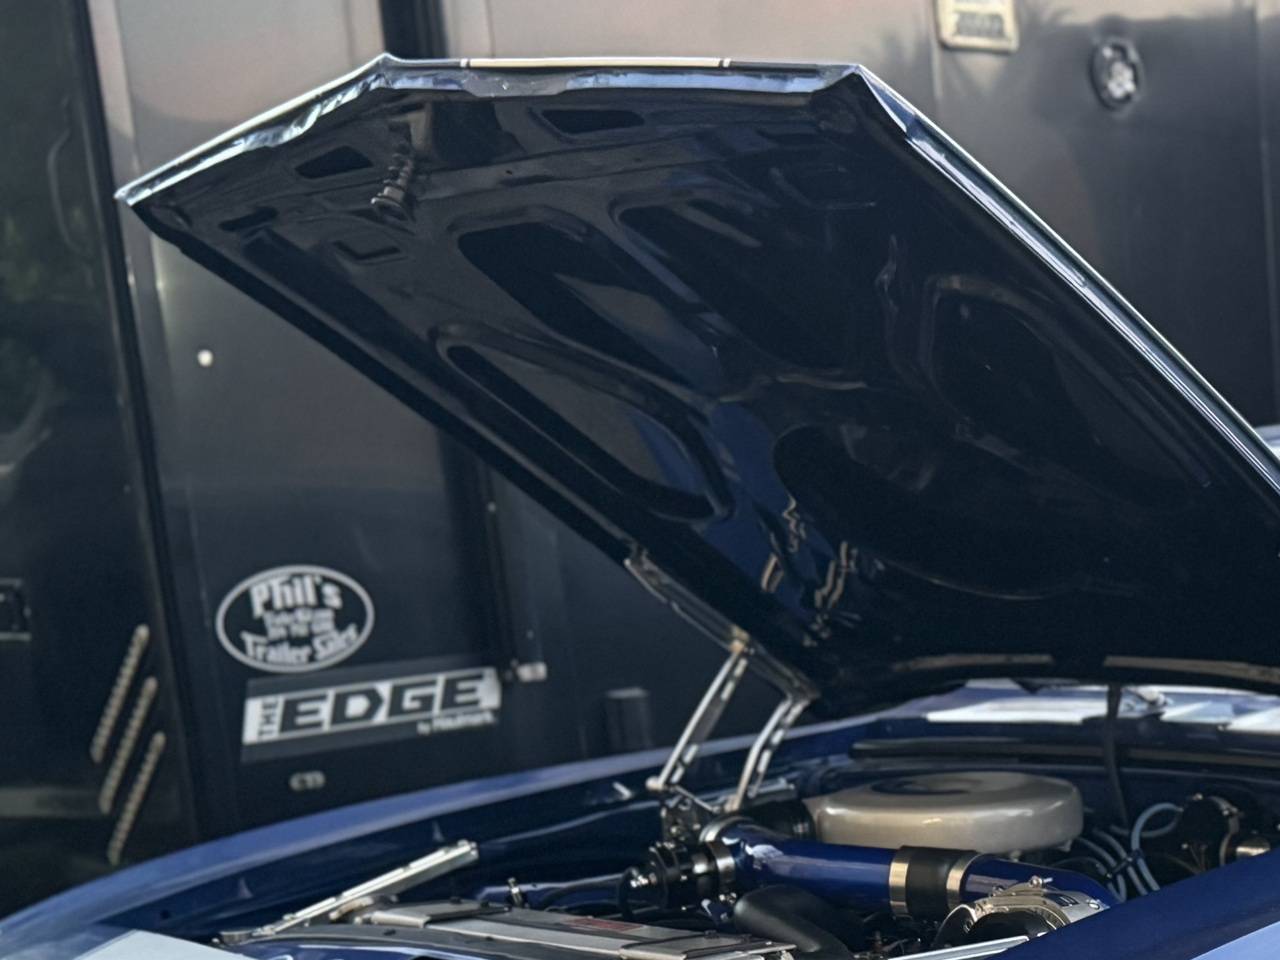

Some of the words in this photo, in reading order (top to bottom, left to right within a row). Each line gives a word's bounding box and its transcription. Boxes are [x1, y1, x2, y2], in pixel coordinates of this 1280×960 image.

[250, 574, 343, 618] Phil's
[240, 631, 313, 665] Trailer
[257, 697, 281, 739] THE
[278, 671, 487, 734] EDGE
